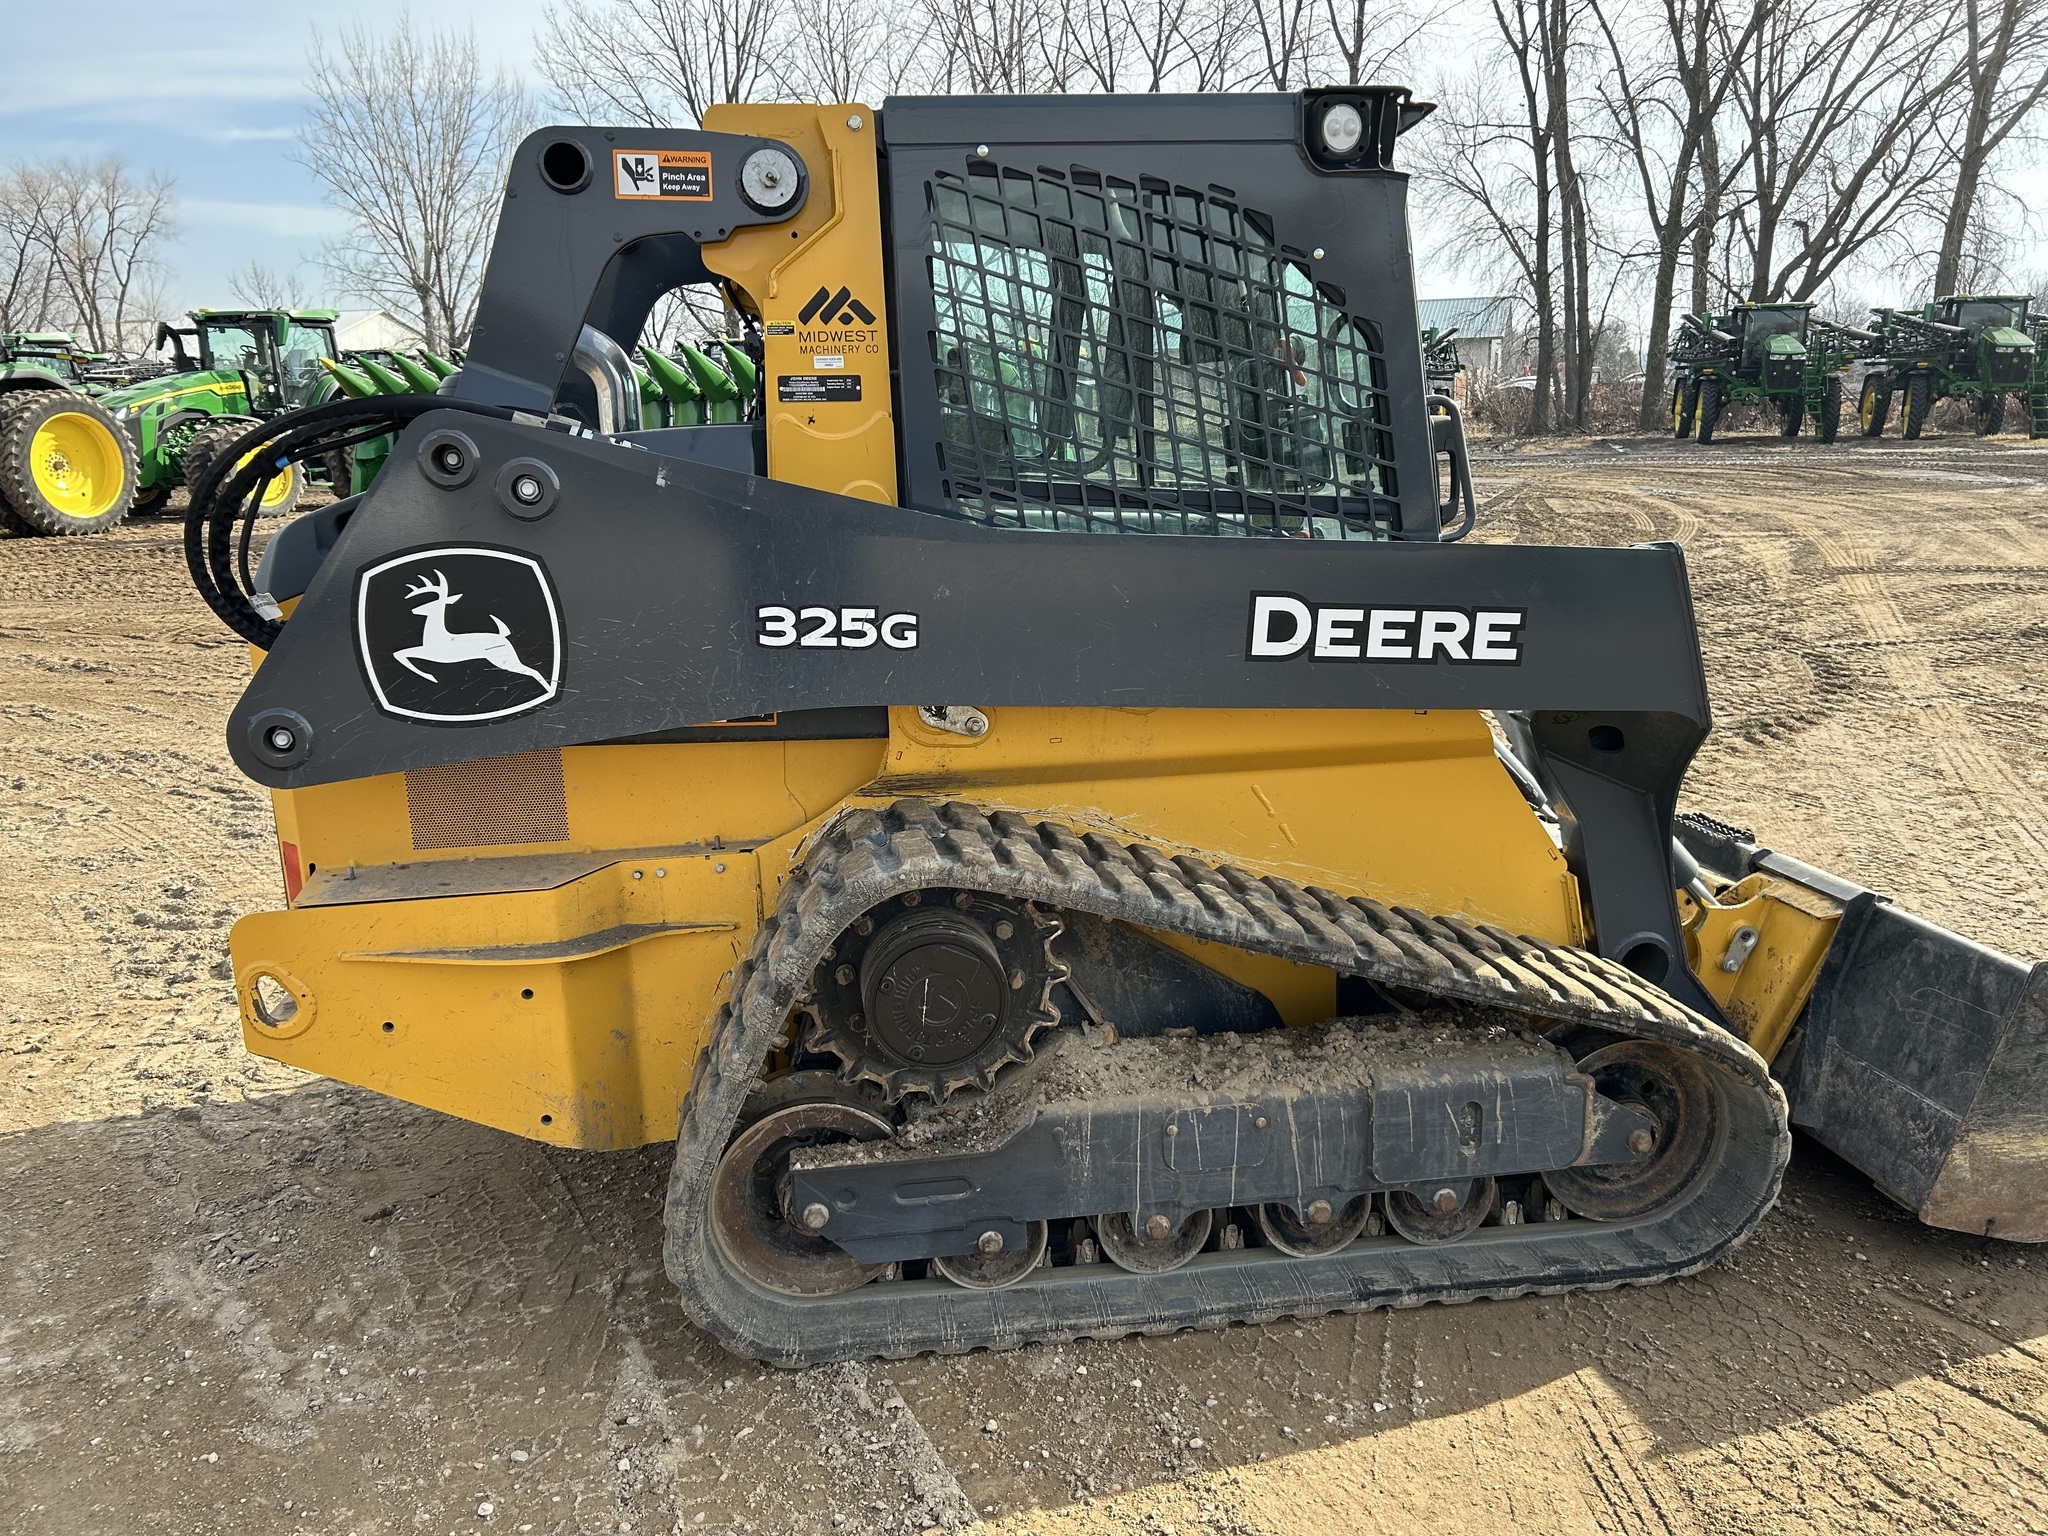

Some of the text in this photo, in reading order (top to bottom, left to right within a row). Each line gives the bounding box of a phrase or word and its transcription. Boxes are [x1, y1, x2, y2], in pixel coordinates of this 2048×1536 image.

[670, 156, 707, 164] WARNING
[662, 172, 706, 182] Pinch Area
[662, 183, 701, 193] Keep Away
[798, 330, 878, 343] MIDWEST
[799, 344, 879, 354] MACHINERY CO
[757, 606, 918, 649] 325G
[1250, 596, 1523, 661] DEERE
